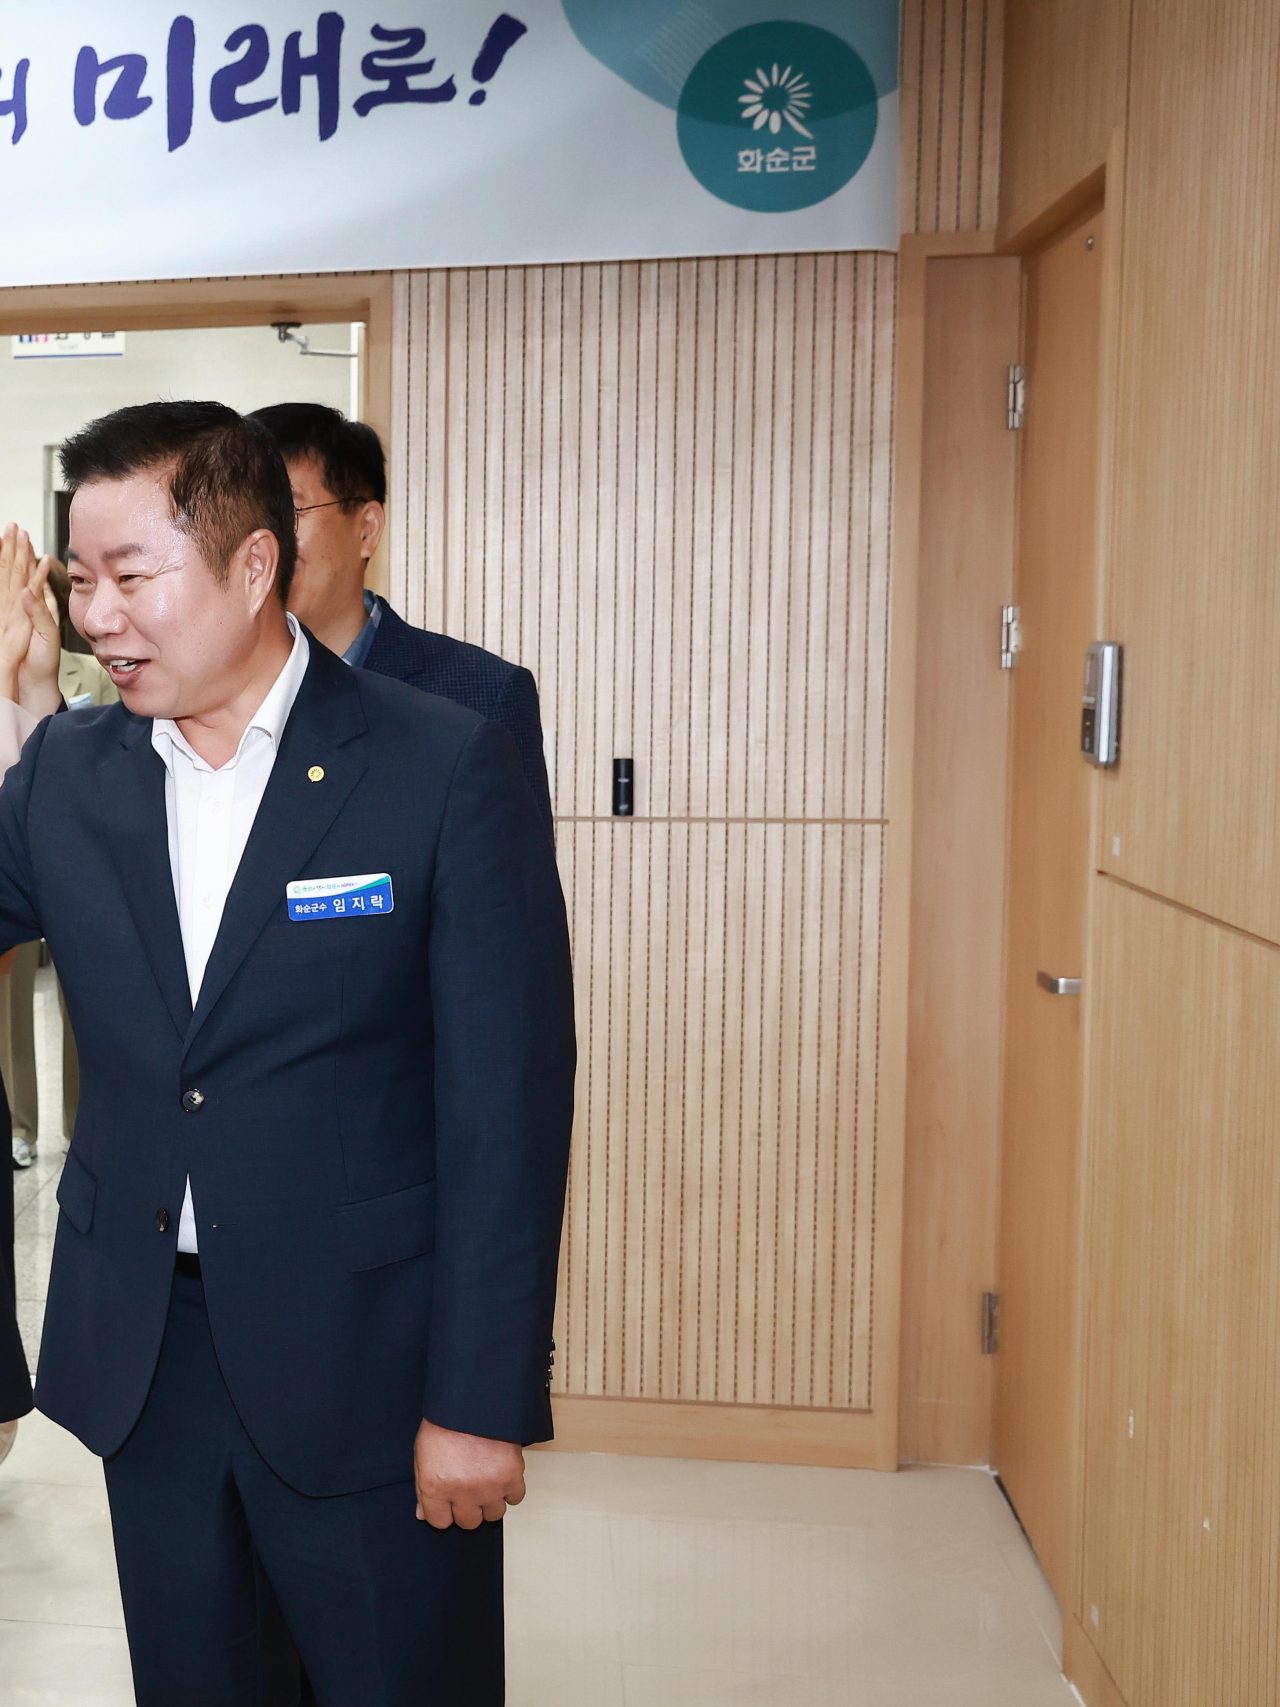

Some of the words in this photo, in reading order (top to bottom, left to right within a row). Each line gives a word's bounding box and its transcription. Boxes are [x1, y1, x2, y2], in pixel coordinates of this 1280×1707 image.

[73, 11, 528, 152] 미래로!
[737, 145, 817, 174] 화순군
[294, 902, 328, 915] 화순군수
